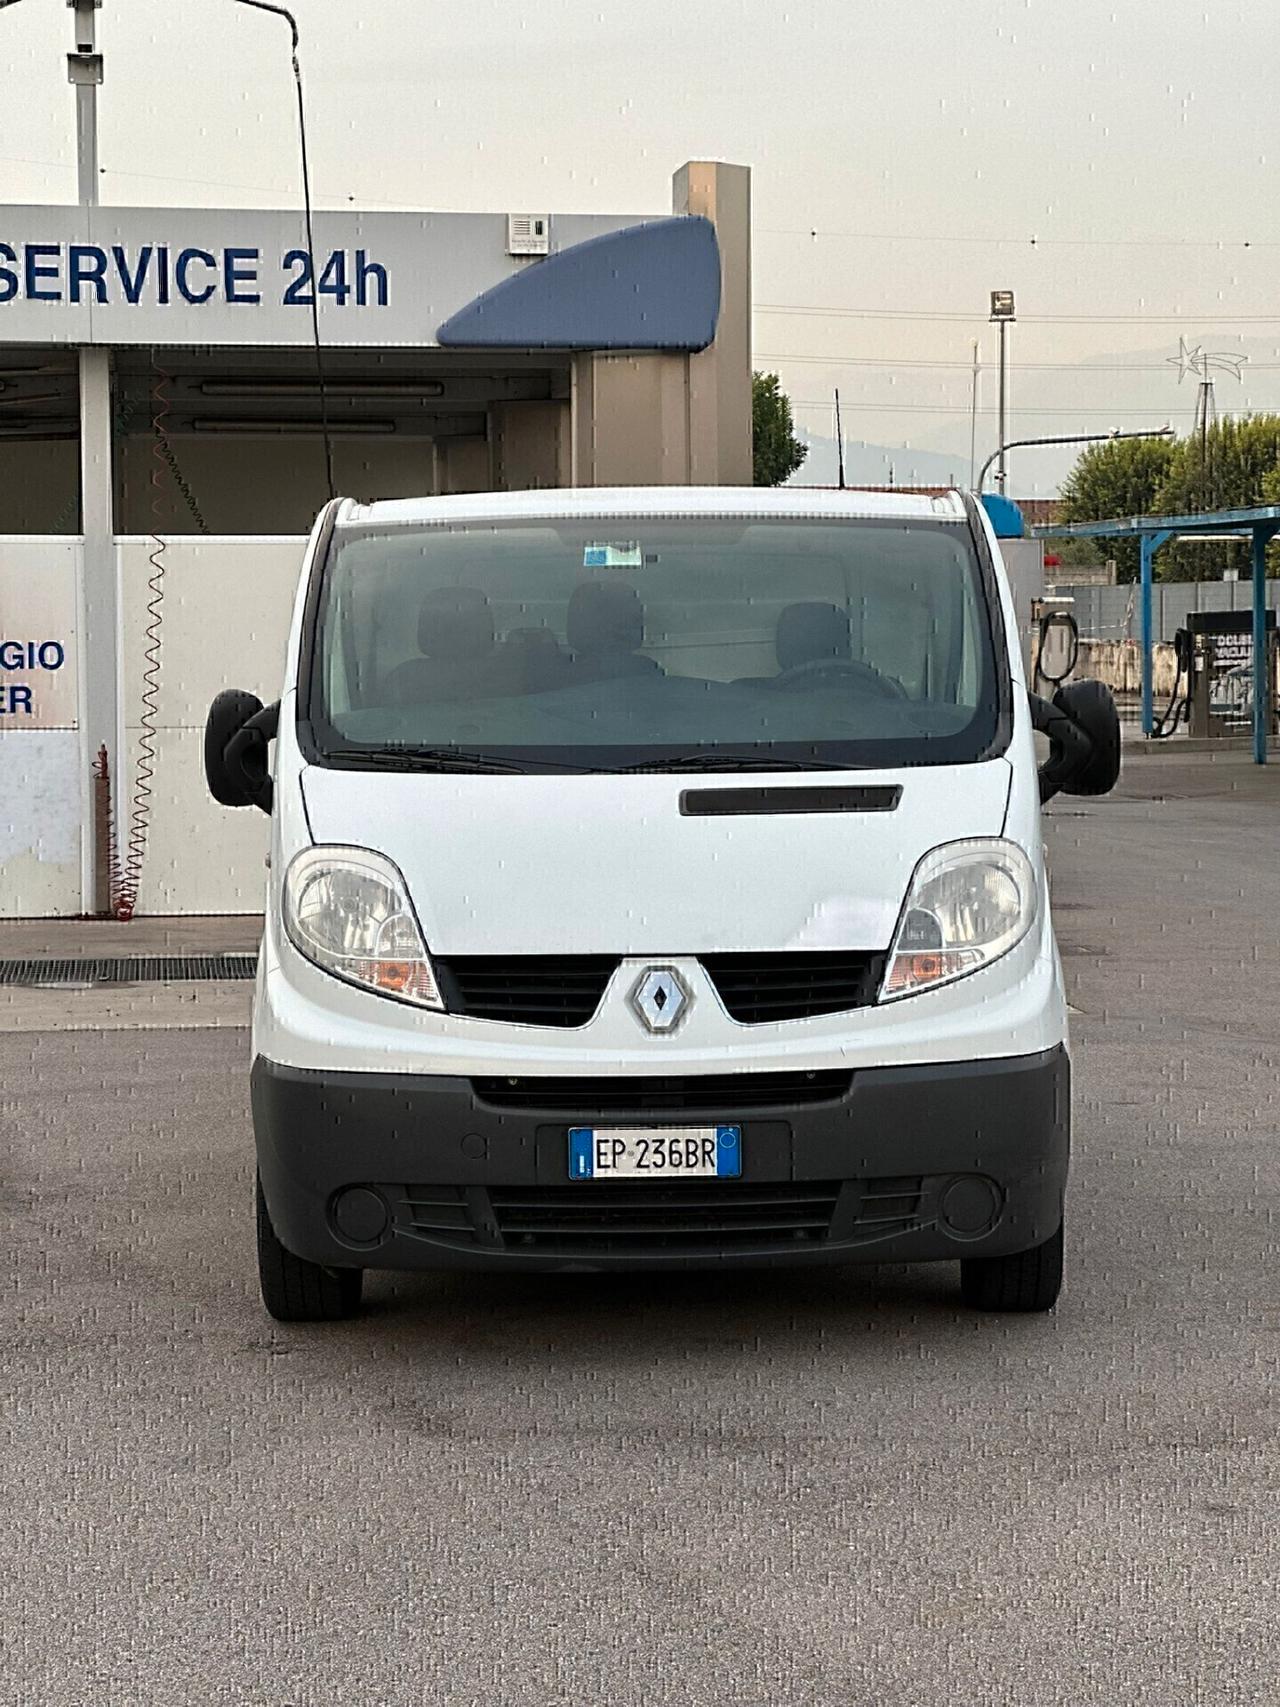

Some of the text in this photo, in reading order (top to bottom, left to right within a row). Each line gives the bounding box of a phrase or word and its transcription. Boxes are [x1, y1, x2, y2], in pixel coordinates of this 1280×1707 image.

[0, 243, 388, 306] SERVICE 24h
[596, 1138, 716, 1169] EP 236BR
